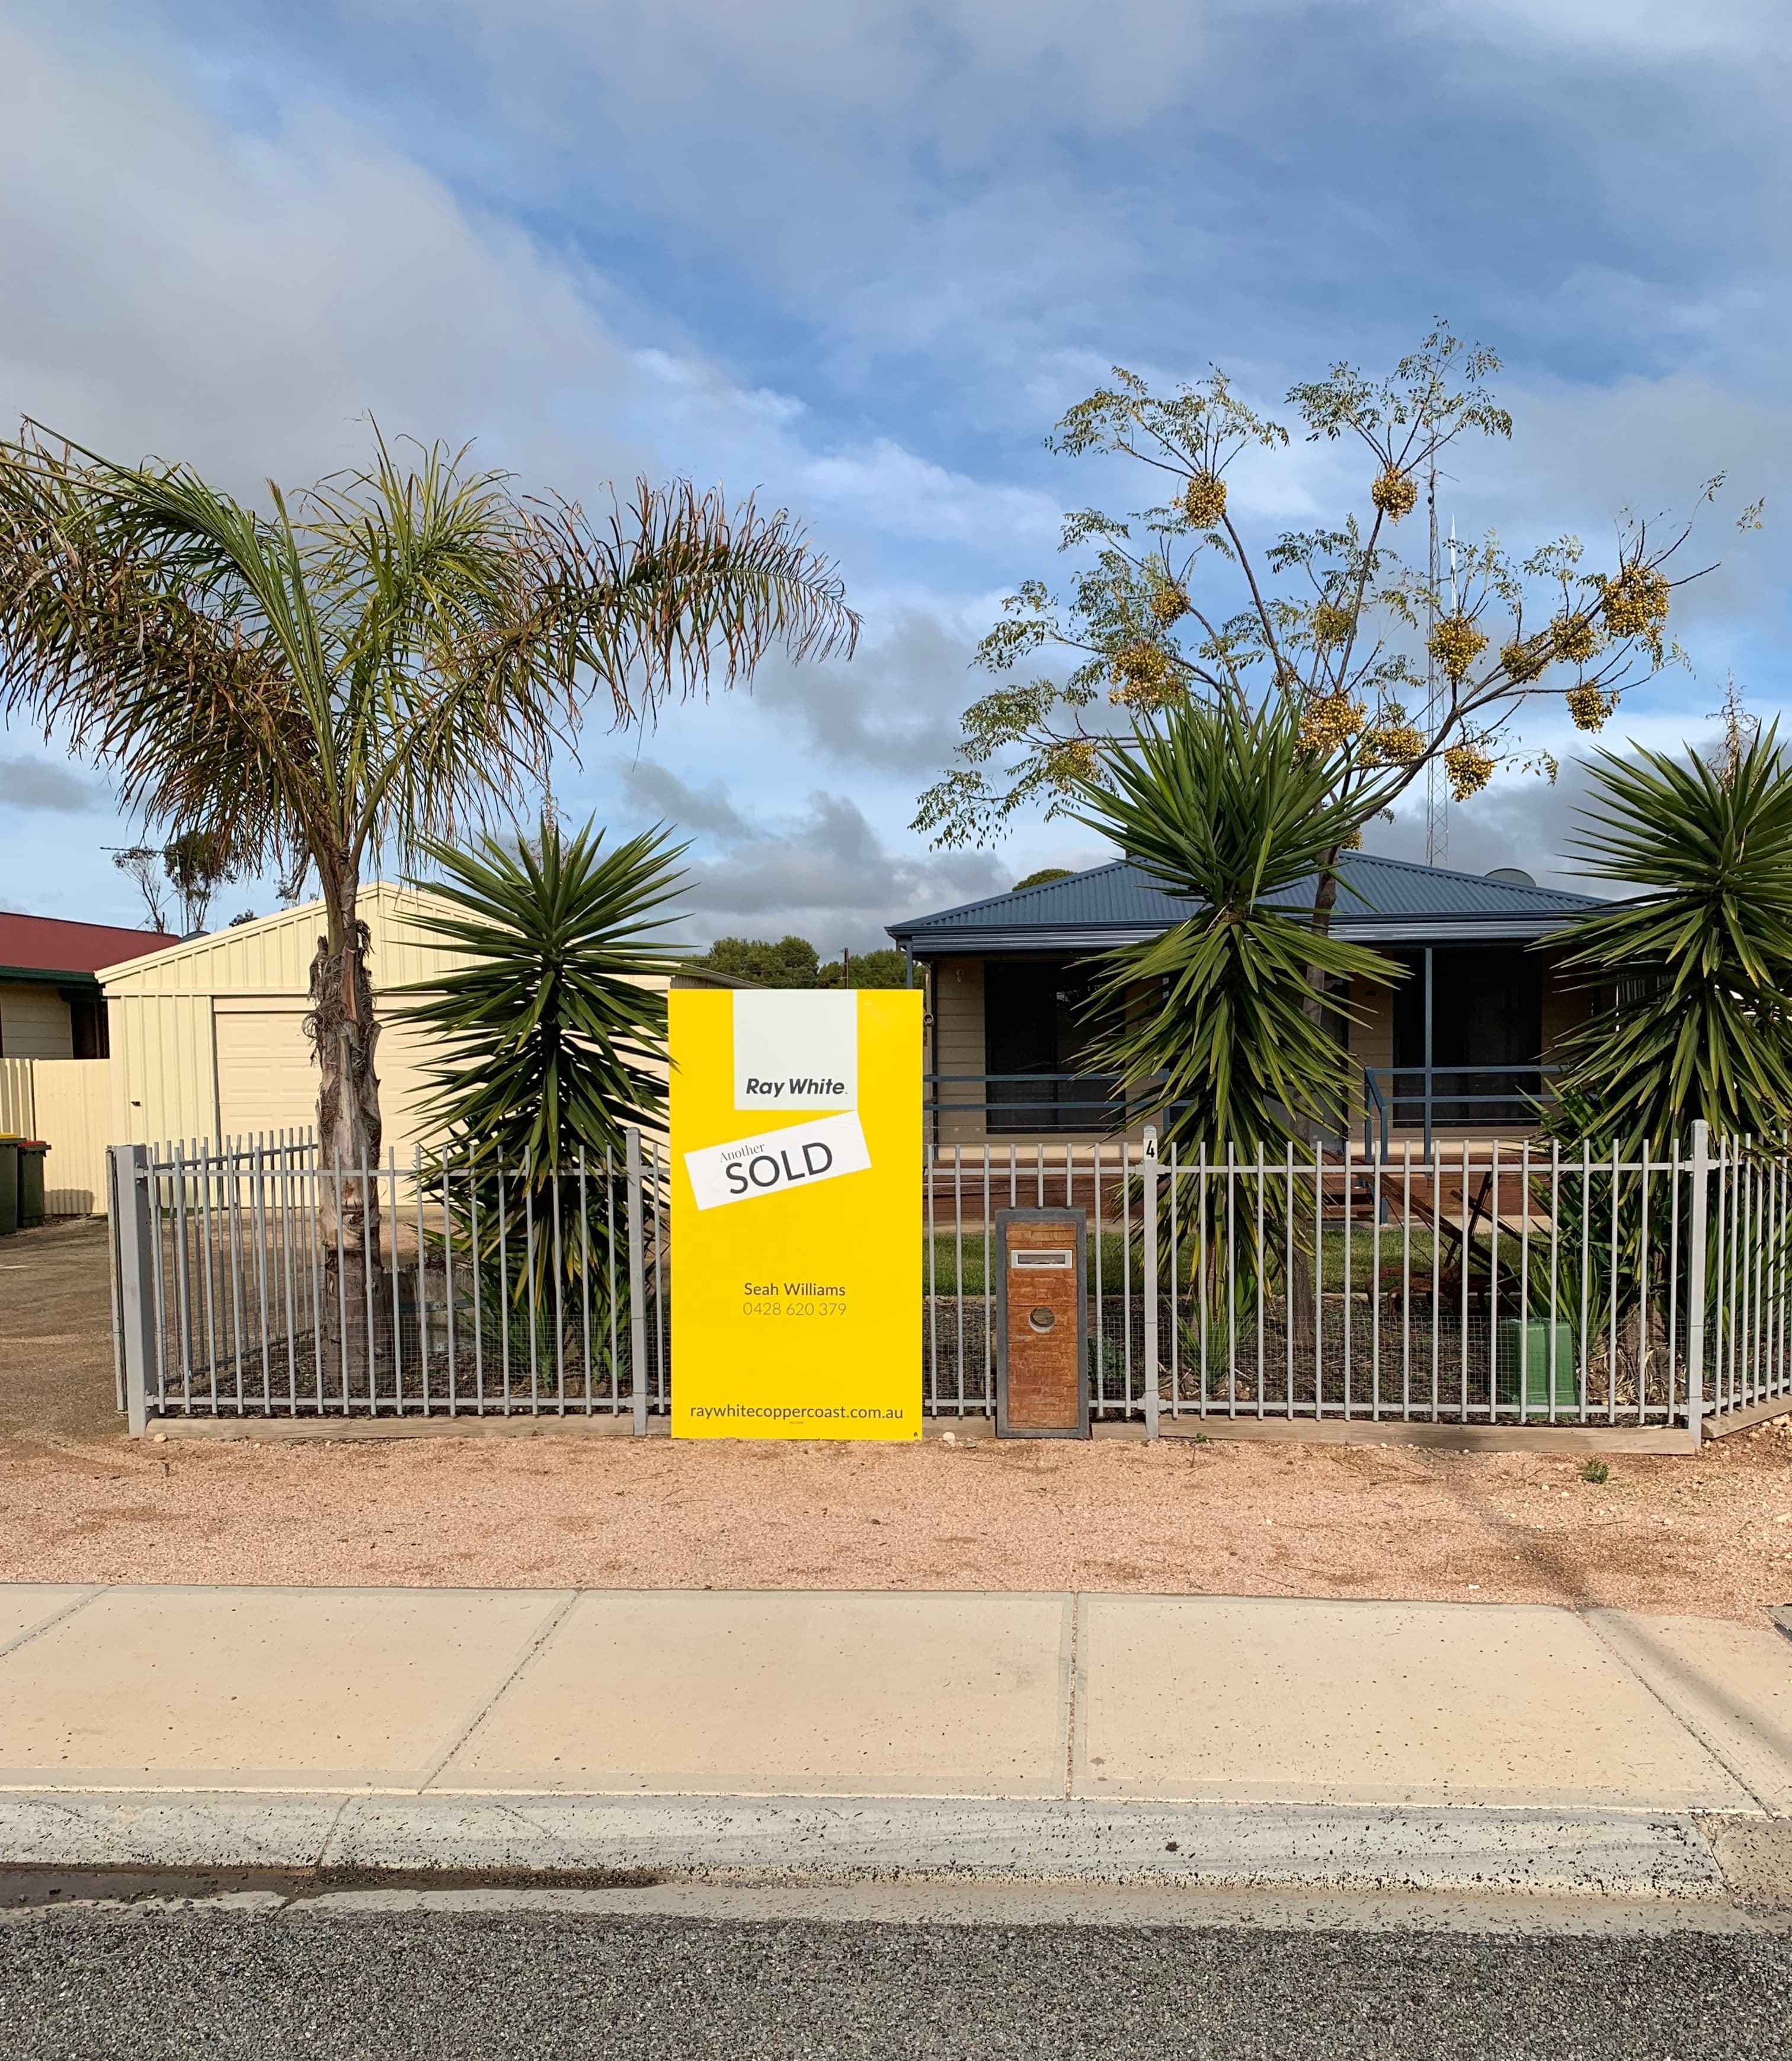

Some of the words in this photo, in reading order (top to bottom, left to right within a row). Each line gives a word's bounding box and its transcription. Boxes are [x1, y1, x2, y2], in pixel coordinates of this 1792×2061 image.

[745, 1078, 785, 1098] Ray
[719, 1142, 765, 1163] Another
[1145, 1140, 1156, 1158] 4
[725, 1141, 833, 1195] SOLD
[744, 1282, 779, 1296] Seah
[783, 1282, 846, 1297] Williams
[743, 1302, 781, 1316] 0428
[786, 1302, 814, 1316] 620
[819, 1302, 846, 1316] 379
[690, 1403, 903, 1420] raywhitecoppercoast.com.au
